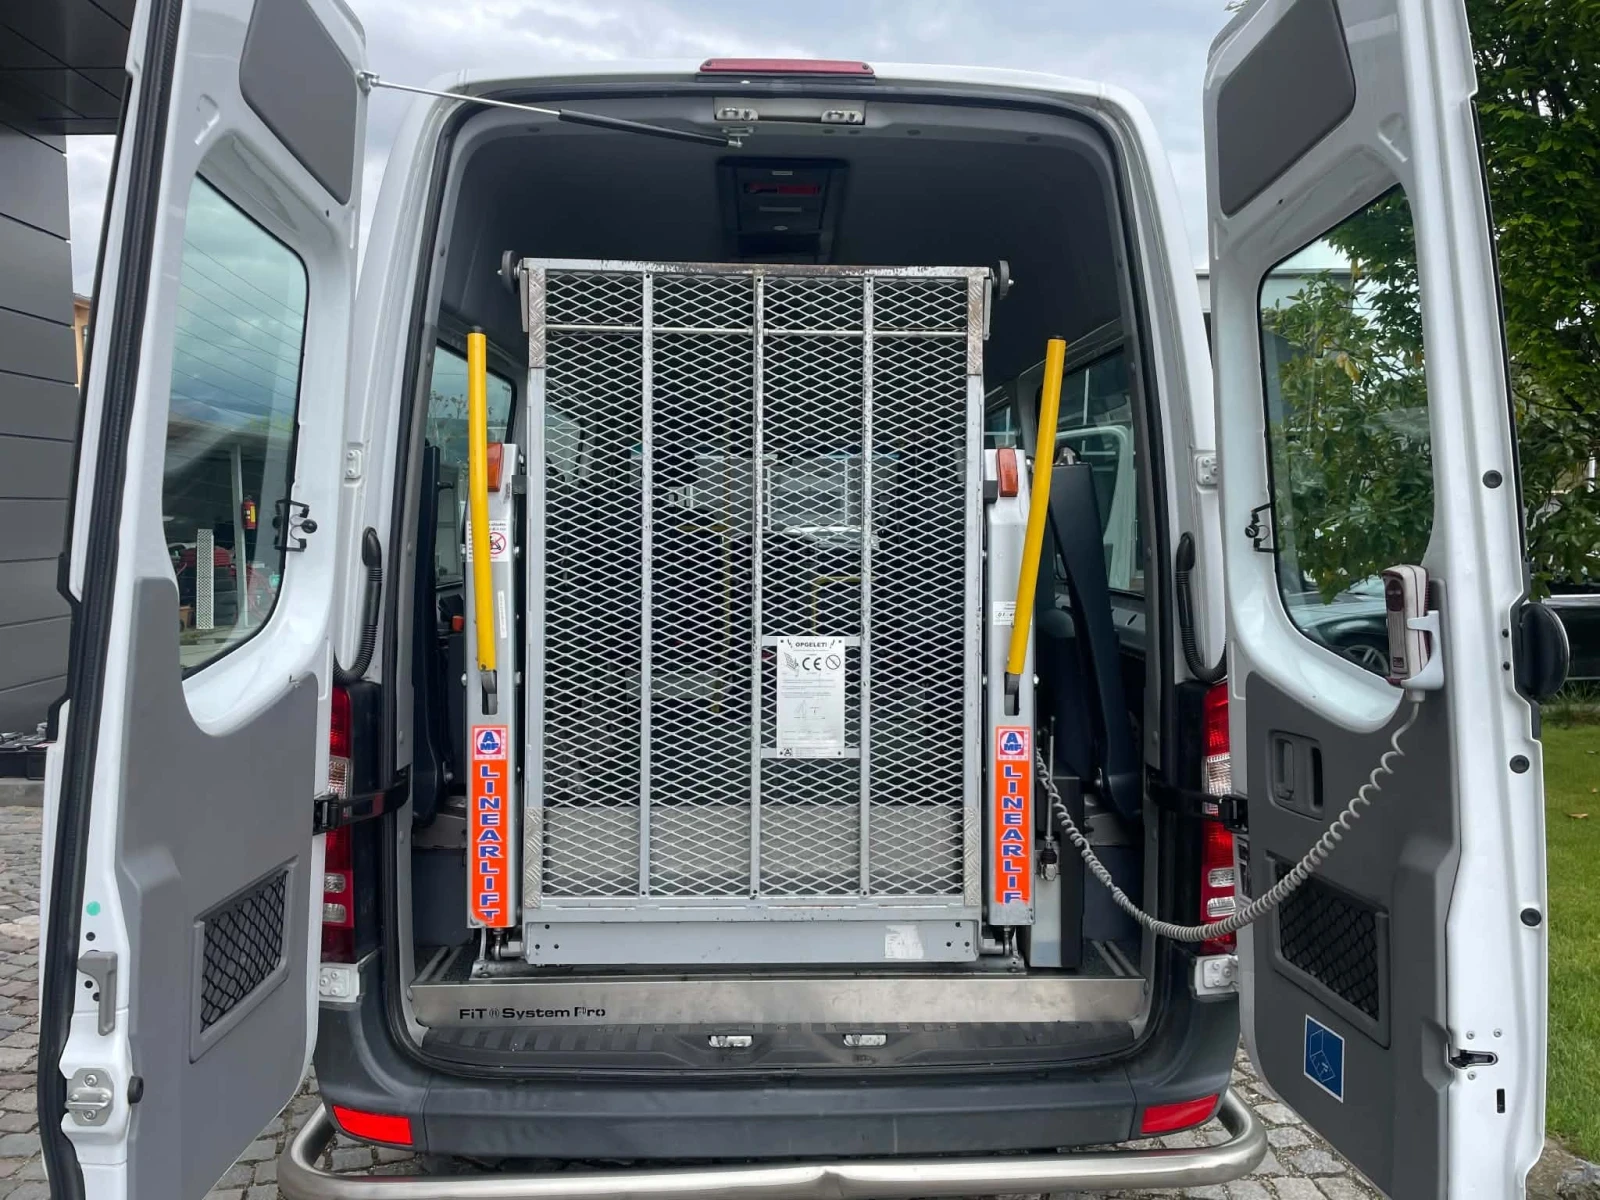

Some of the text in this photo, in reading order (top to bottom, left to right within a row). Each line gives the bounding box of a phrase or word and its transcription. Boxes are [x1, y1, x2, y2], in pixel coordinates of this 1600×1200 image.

[802, 657, 822, 671] CE
[478, 765, 503, 923] LINEARLIFT
[502, 1007, 570, 1020] System
[574, 1006, 606, 1017] Pro
